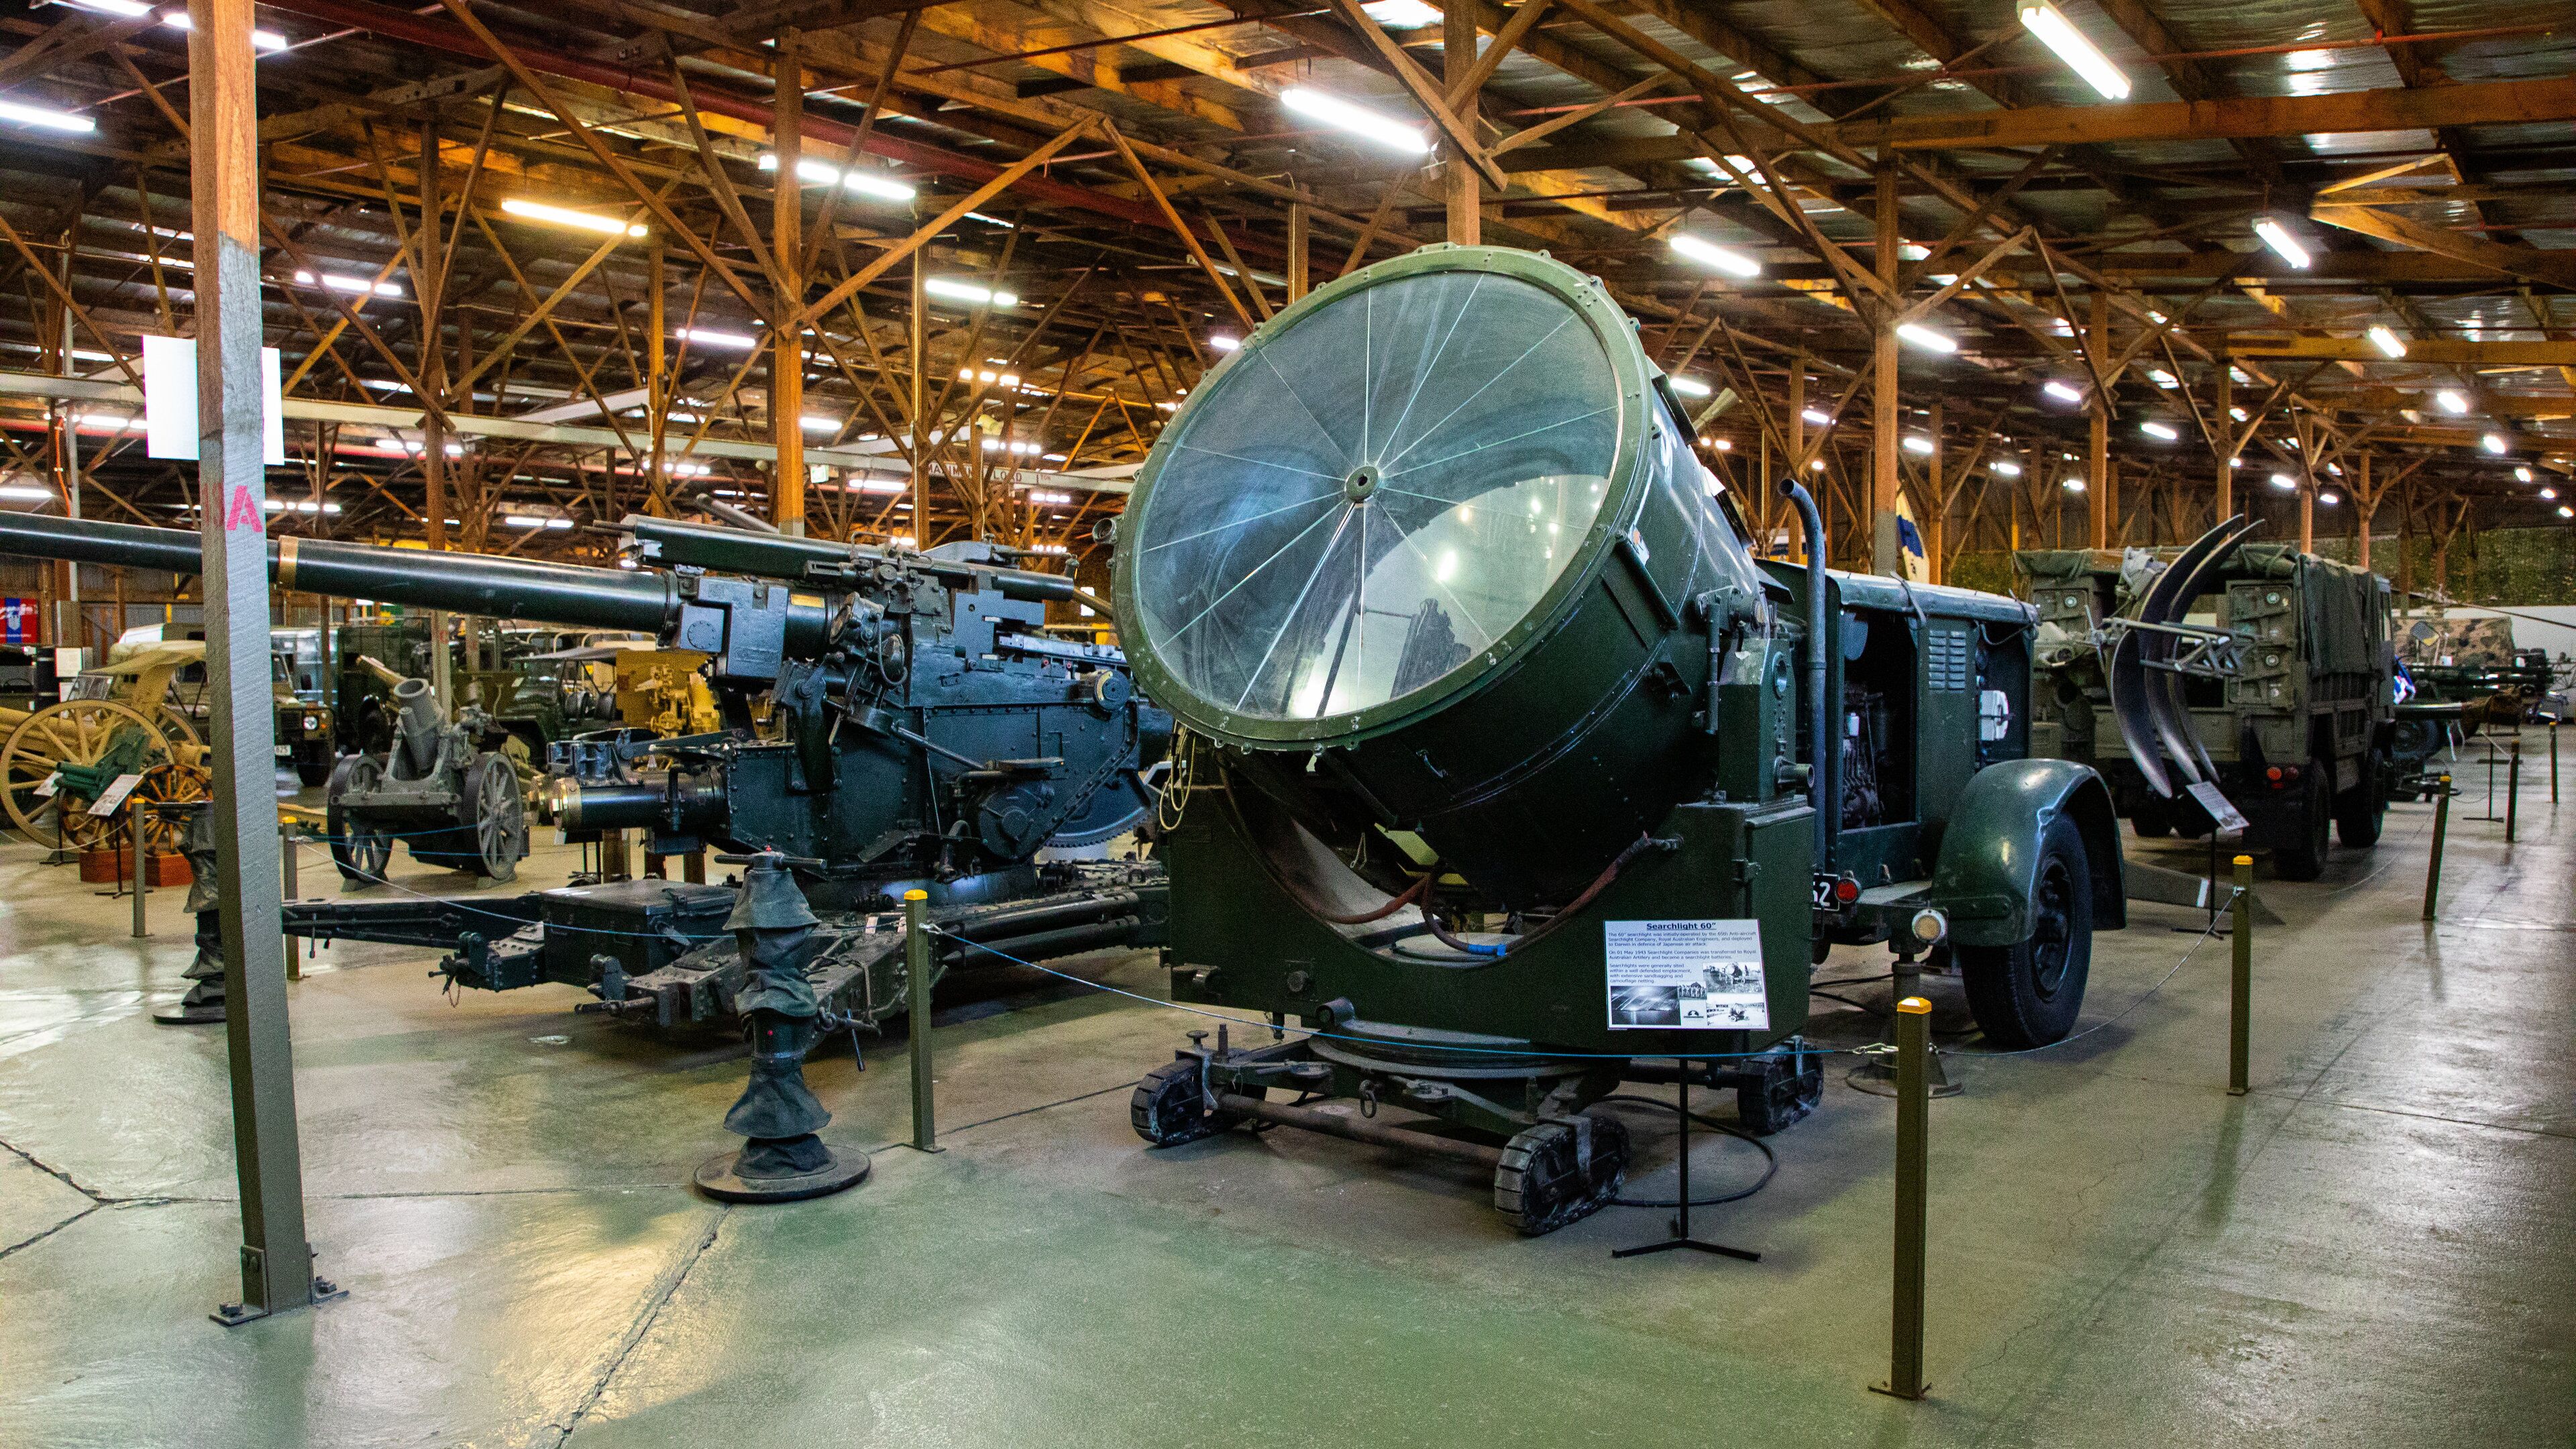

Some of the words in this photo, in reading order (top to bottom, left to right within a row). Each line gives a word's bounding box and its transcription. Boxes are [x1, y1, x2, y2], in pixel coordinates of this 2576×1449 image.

[994, 470, 1022, 482] LOD
[226, 485, 264, 533] A
[1646, 922, 1699, 930] Searchlight
